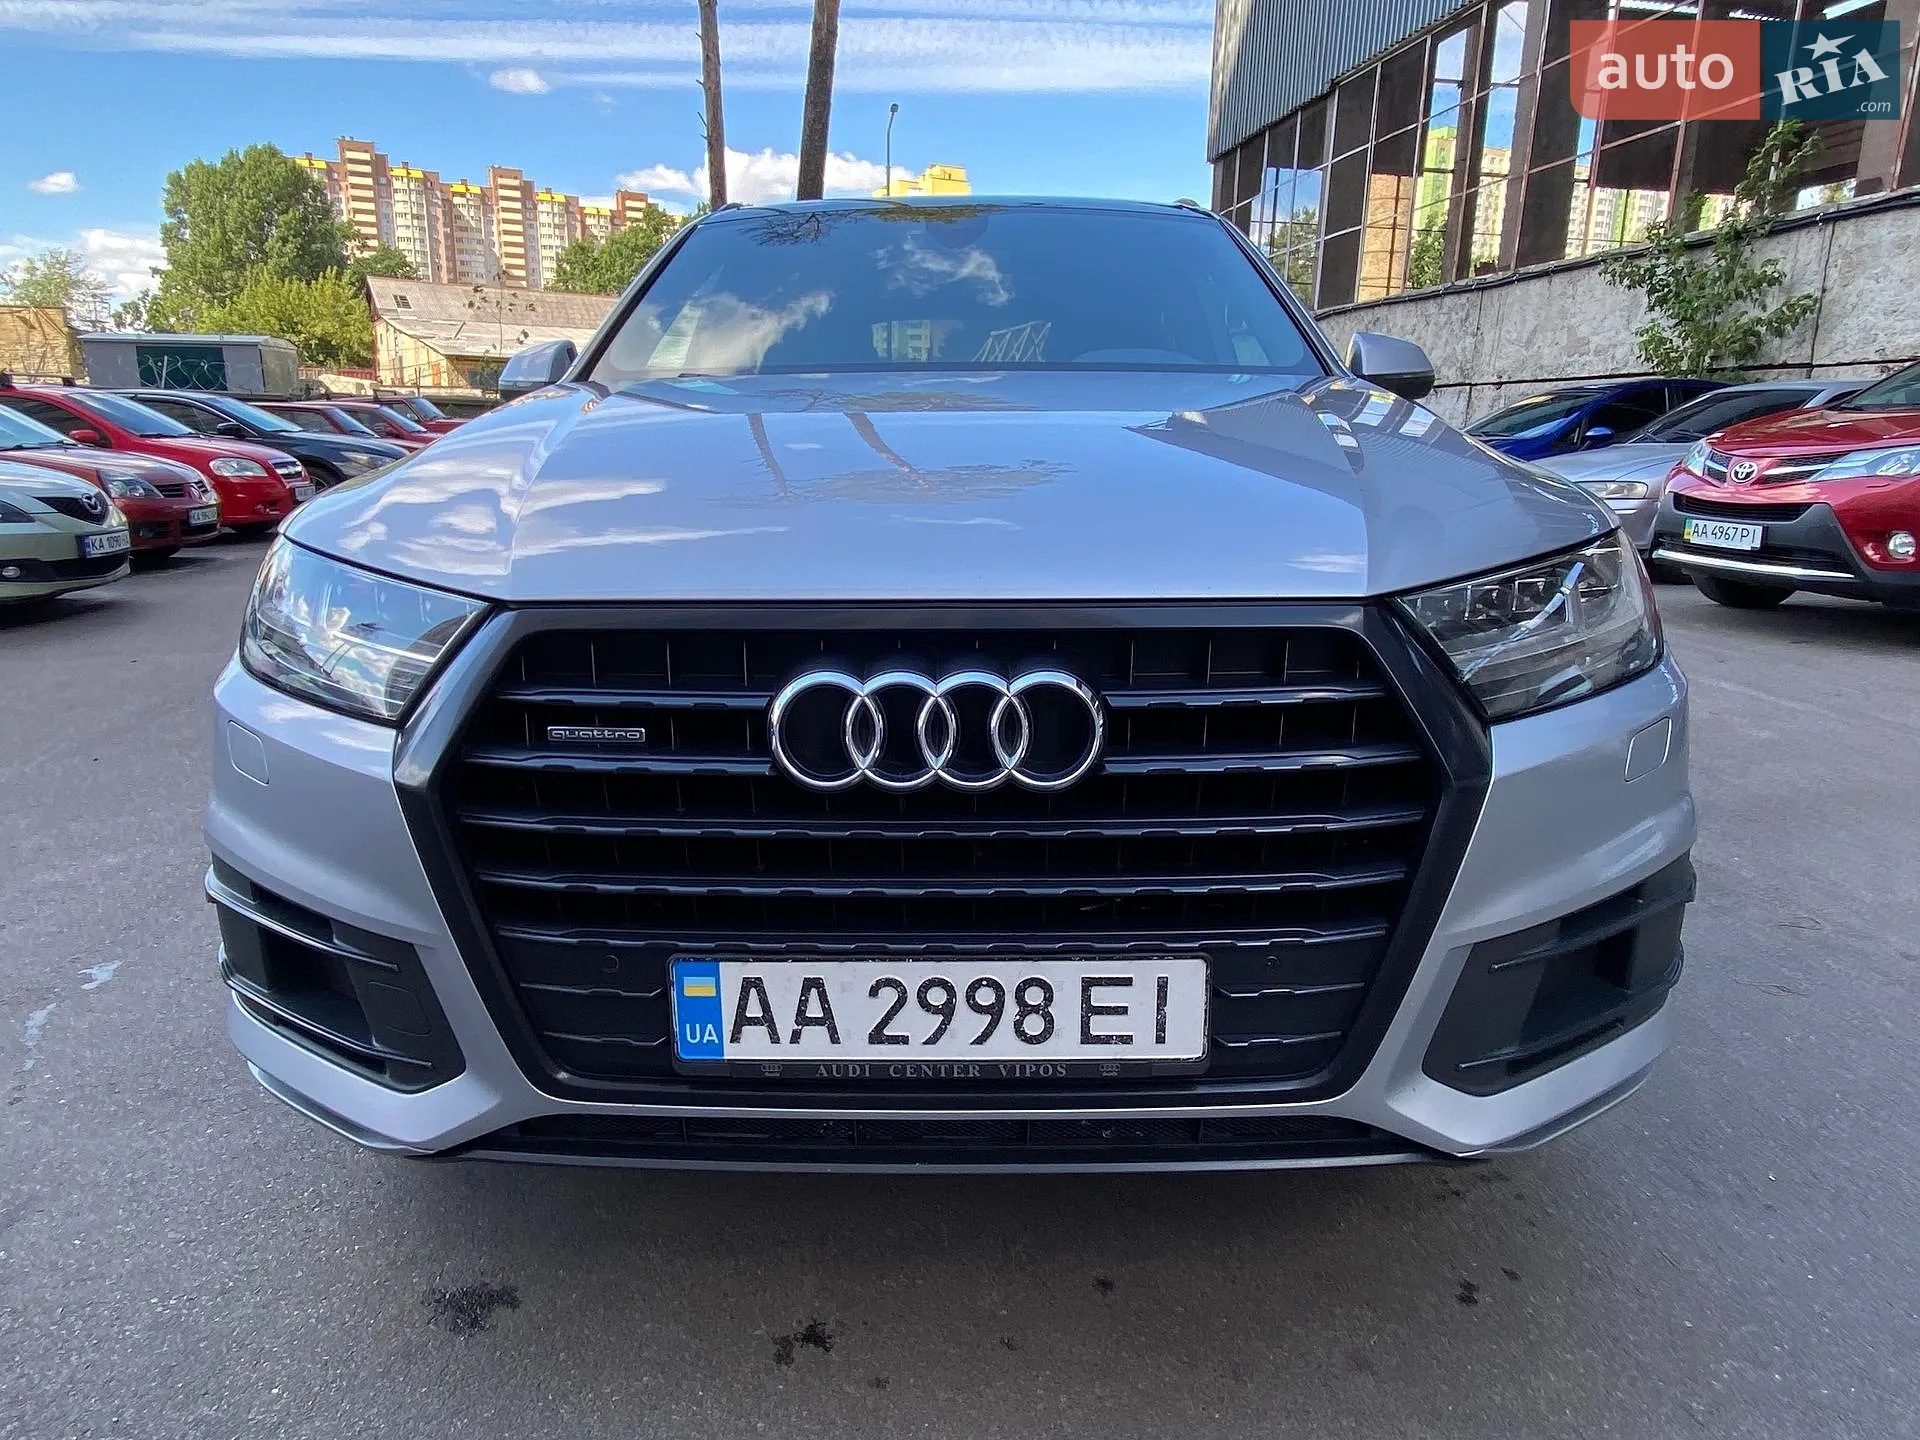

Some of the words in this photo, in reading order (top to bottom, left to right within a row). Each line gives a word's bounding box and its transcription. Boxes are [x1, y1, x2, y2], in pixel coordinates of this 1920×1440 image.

[1692, 523, 1708, 538] AA
[1711, 525, 1738, 541] 4967
[1740, 528, 1756, 544] PI
[90, 537, 104, 551] KA
[552, 730, 640, 739] quattro
[729, 976, 841, 1045] AA
[867, 976, 1055, 1046] 2998
[1080, 976, 1169, 1045] EI
[685, 1023, 719, 1044] UA
[815, 1064, 871, 1078] AUDI
[889, 1064, 981, 1078] CENTER
[999, 1064, 1067, 1078] VIPOS
